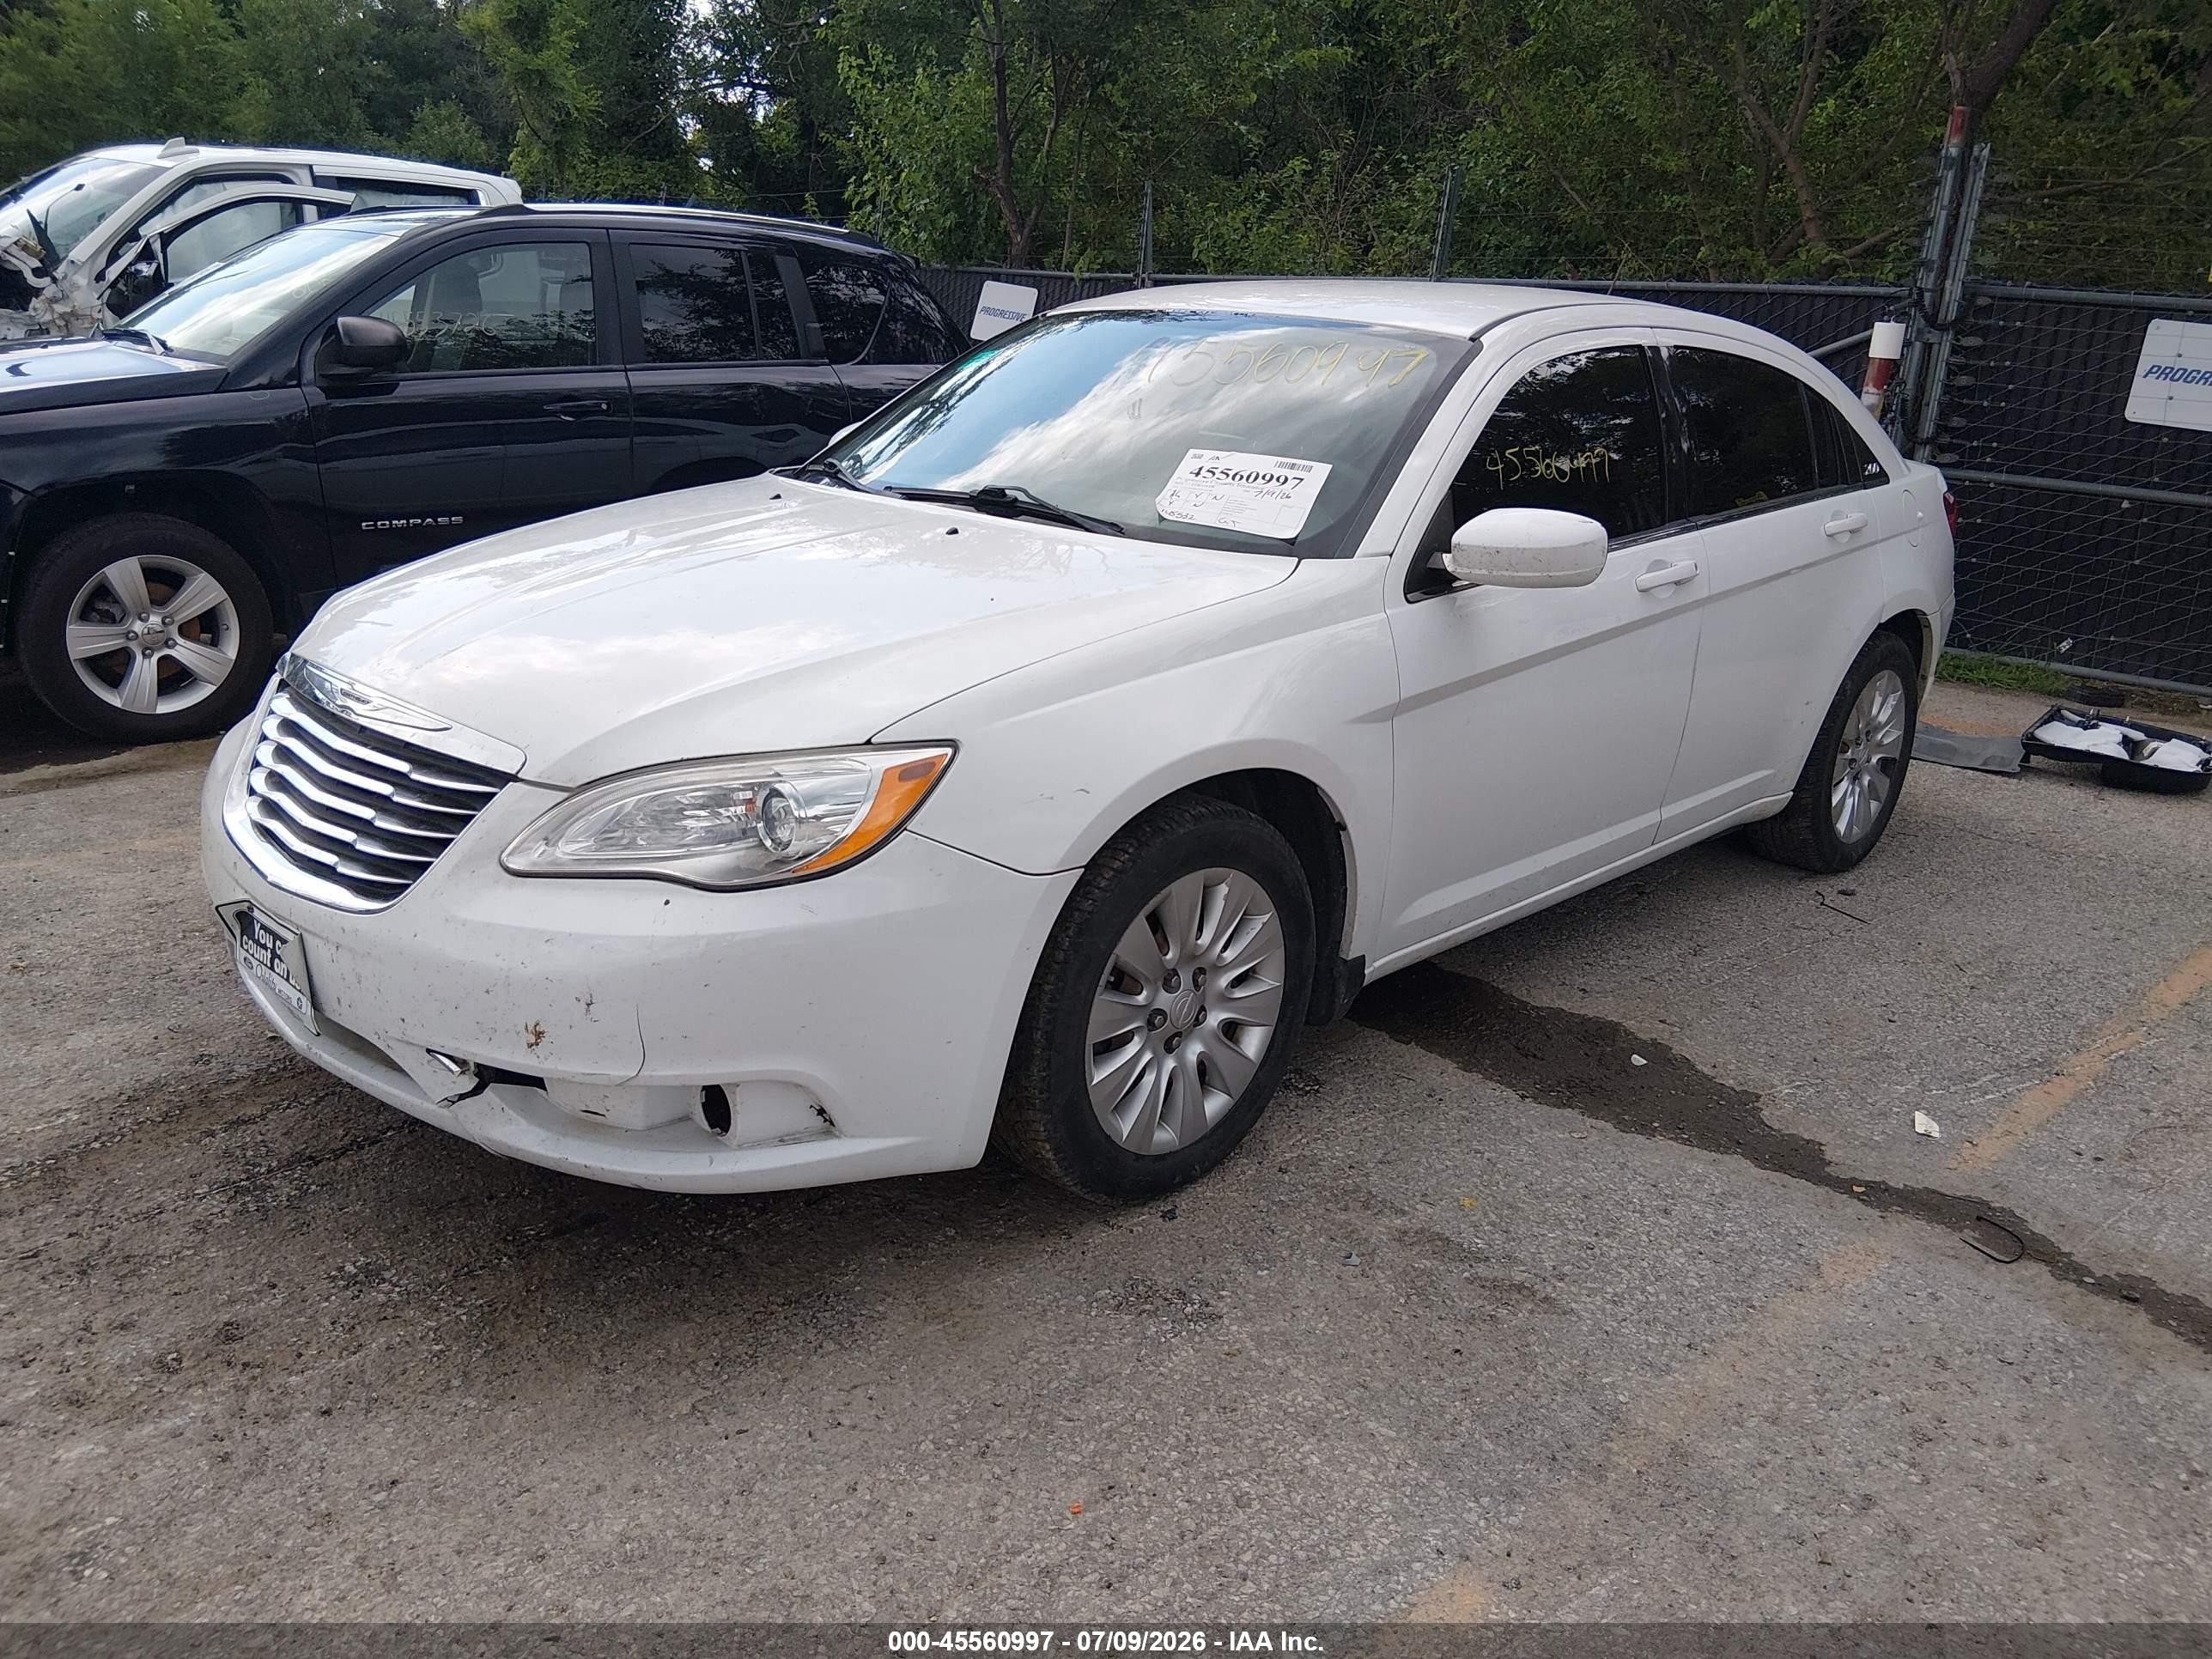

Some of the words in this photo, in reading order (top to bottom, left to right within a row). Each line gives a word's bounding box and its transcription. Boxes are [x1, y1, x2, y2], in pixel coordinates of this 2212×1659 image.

[979, 306, 1028, 322] PROGRESSIVE
[2142, 364, 2212, 386] PROGR
[1189, 465, 1305, 491] 45560997
[362, 516, 464, 530] COMPASS
[253, 919, 273, 950] You
[242, 934, 271, 968] count
[273, 957, 288, 979] on
